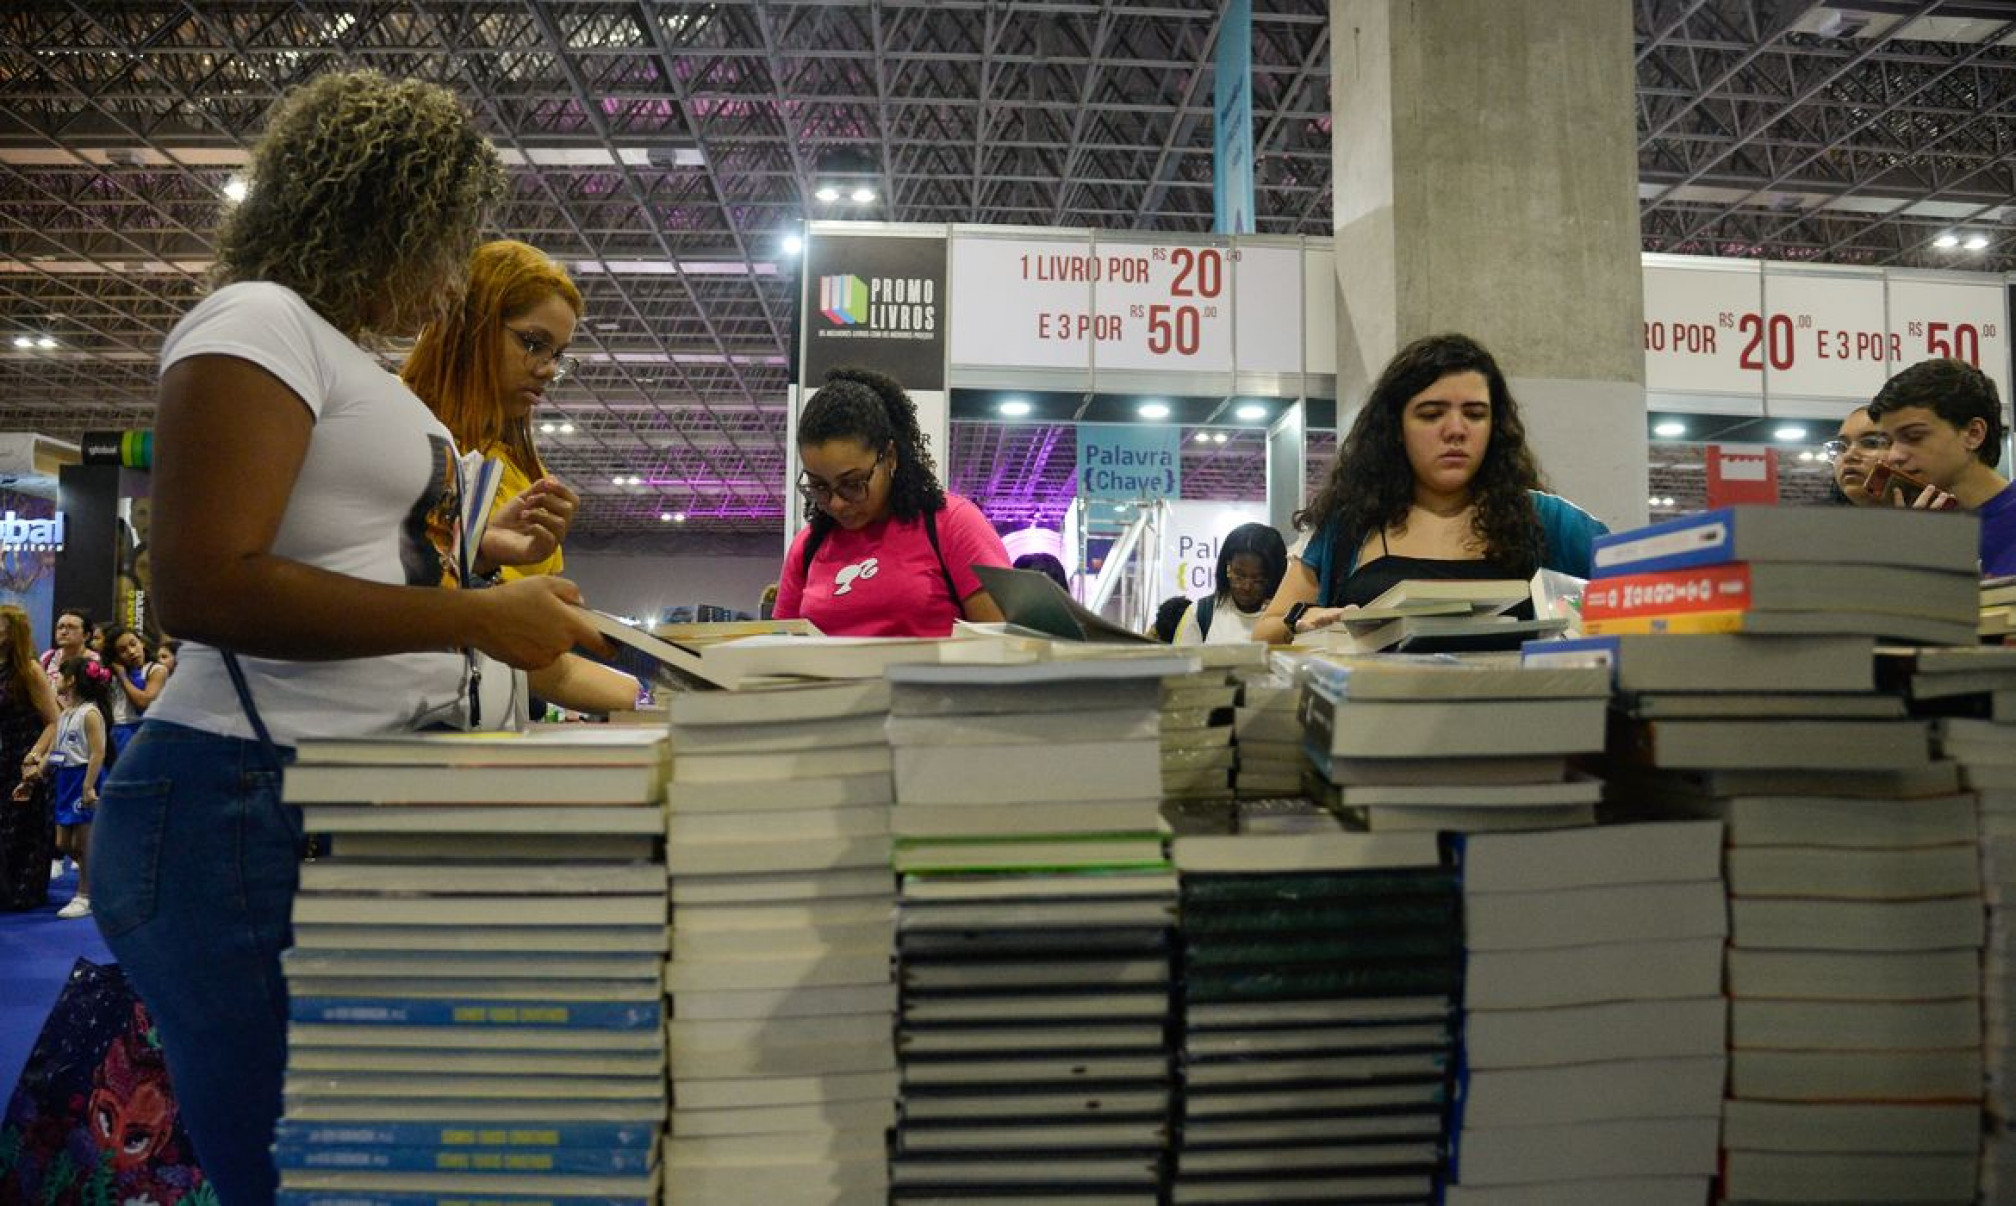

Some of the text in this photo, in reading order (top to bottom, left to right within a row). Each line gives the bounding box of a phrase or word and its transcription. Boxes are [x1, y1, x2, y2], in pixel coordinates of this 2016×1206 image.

[1021, 254, 1028, 280] 1
[1037, 254, 1101, 281] LIVRO
[1108, 257, 1149, 283] POR
[1171, 247, 1222, 298] 20
[871, 278, 934, 304] PROMO
[870, 304, 935, 330] LIVROS
[1039, 313, 1051, 339] E
[1057, 314, 1071, 340] 3
[1077, 314, 1123, 341] POR
[1148, 304, 1200, 355] 50
[1672, 323, 1717, 354] POR
[1739, 313, 1795, 371] 20
[1817, 330, 1830, 359] E
[1836, 330, 1850, 359] 3
[1857, 332, 1901, 361] POR
[1927, 321, 1979, 371] 50
[1086, 444, 1172, 467] Palavra
[0, 511, 64, 543] bal
